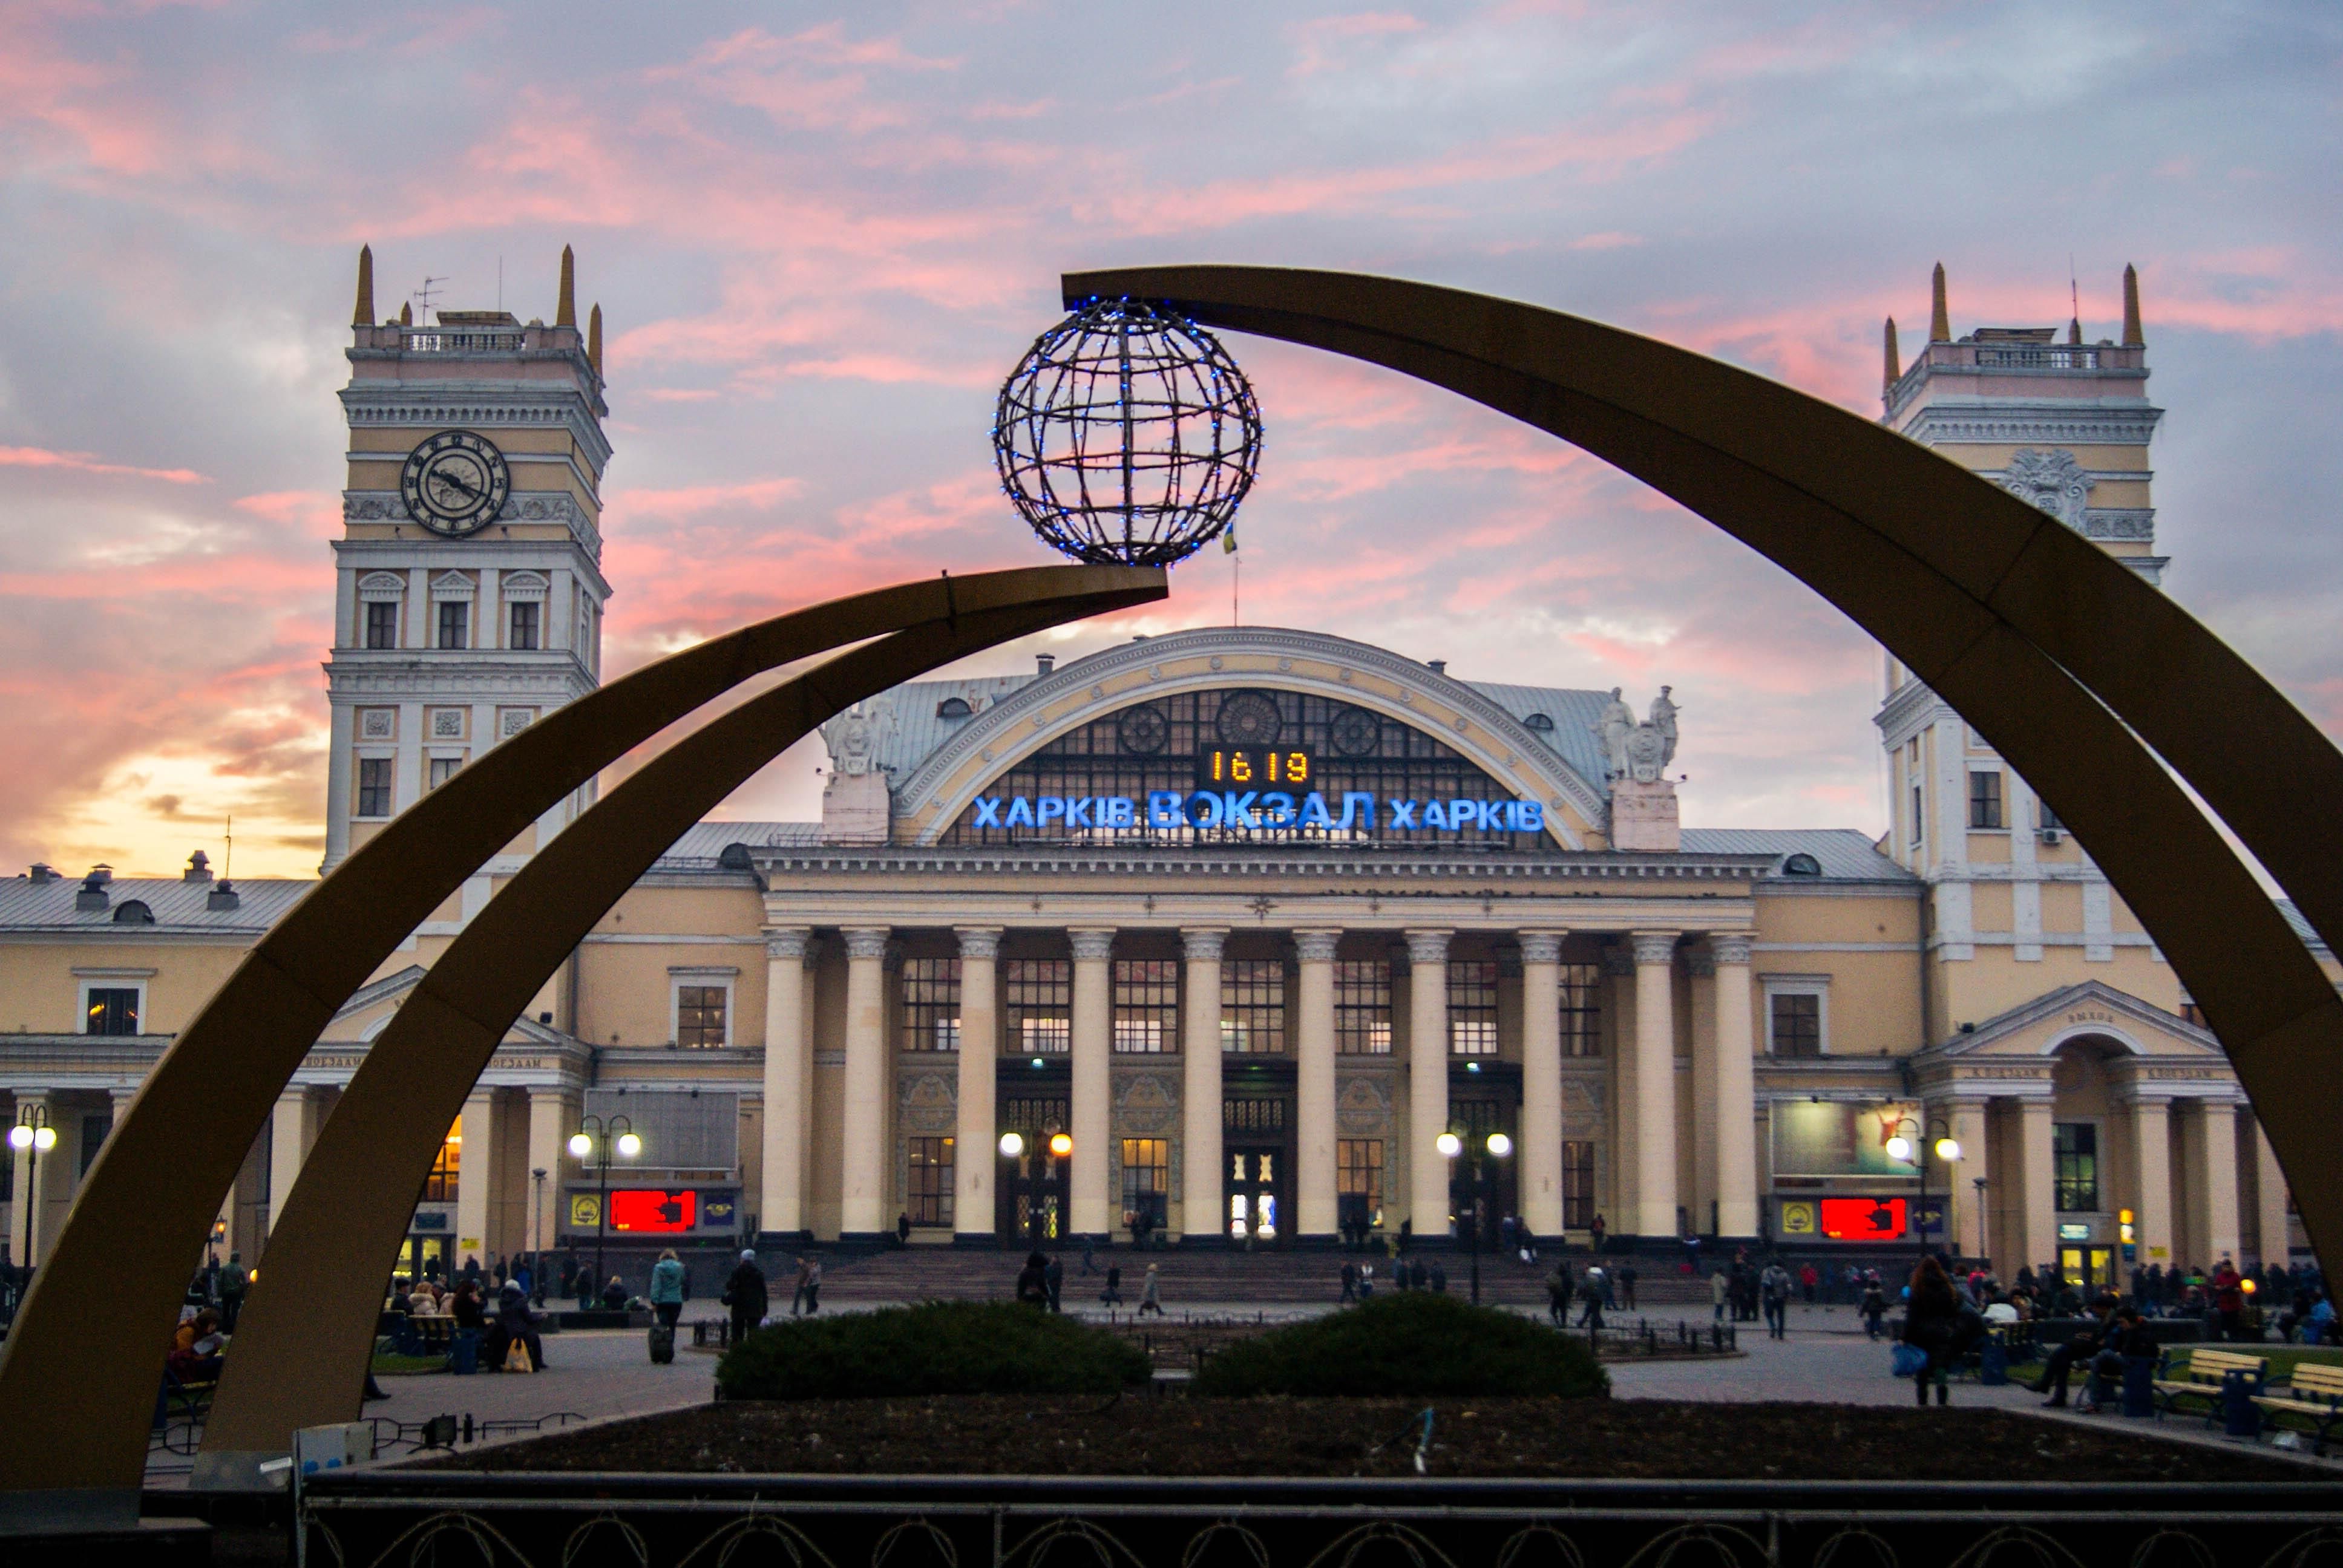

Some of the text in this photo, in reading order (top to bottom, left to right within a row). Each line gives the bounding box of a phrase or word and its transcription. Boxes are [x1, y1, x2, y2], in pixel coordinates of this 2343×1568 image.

[1214, 751, 1251, 781] 16
[972, 789, 1545, 833] ХАРКІВ ВОКЗАЛ ХАРКІВ
